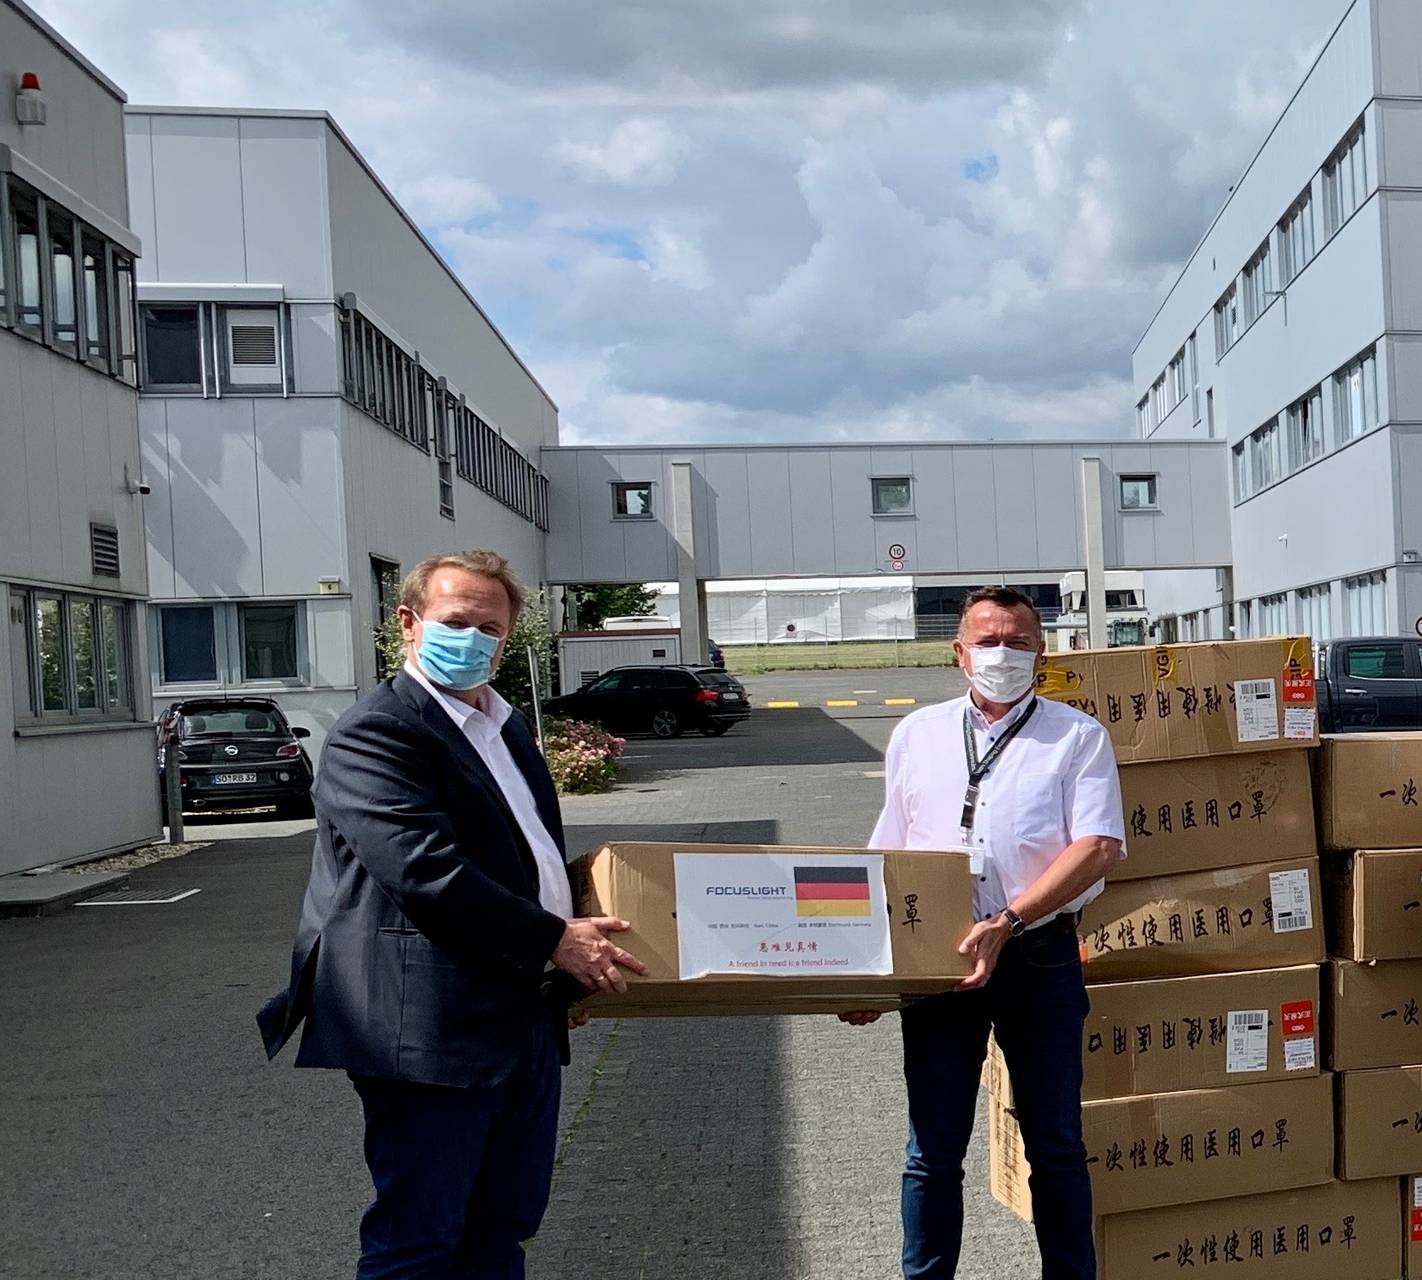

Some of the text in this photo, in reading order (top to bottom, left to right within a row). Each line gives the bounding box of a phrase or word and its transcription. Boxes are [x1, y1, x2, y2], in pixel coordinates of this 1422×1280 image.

[1130, 790, 1268, 838] 使用医用口罩
[706, 886, 787, 896] FOCUSLIGHT
[902, 893, 922, 933] 罩
[736, 959, 759, 968] friend
[768, 959, 787, 967] need
[801, 957, 823, 967] friend
[824, 957, 849, 966] indeed
[1083, 1118, 1289, 1172] 一次性使用医用口罩
[1152, 1215, 1358, 1267] 一次性使用医用口罩
